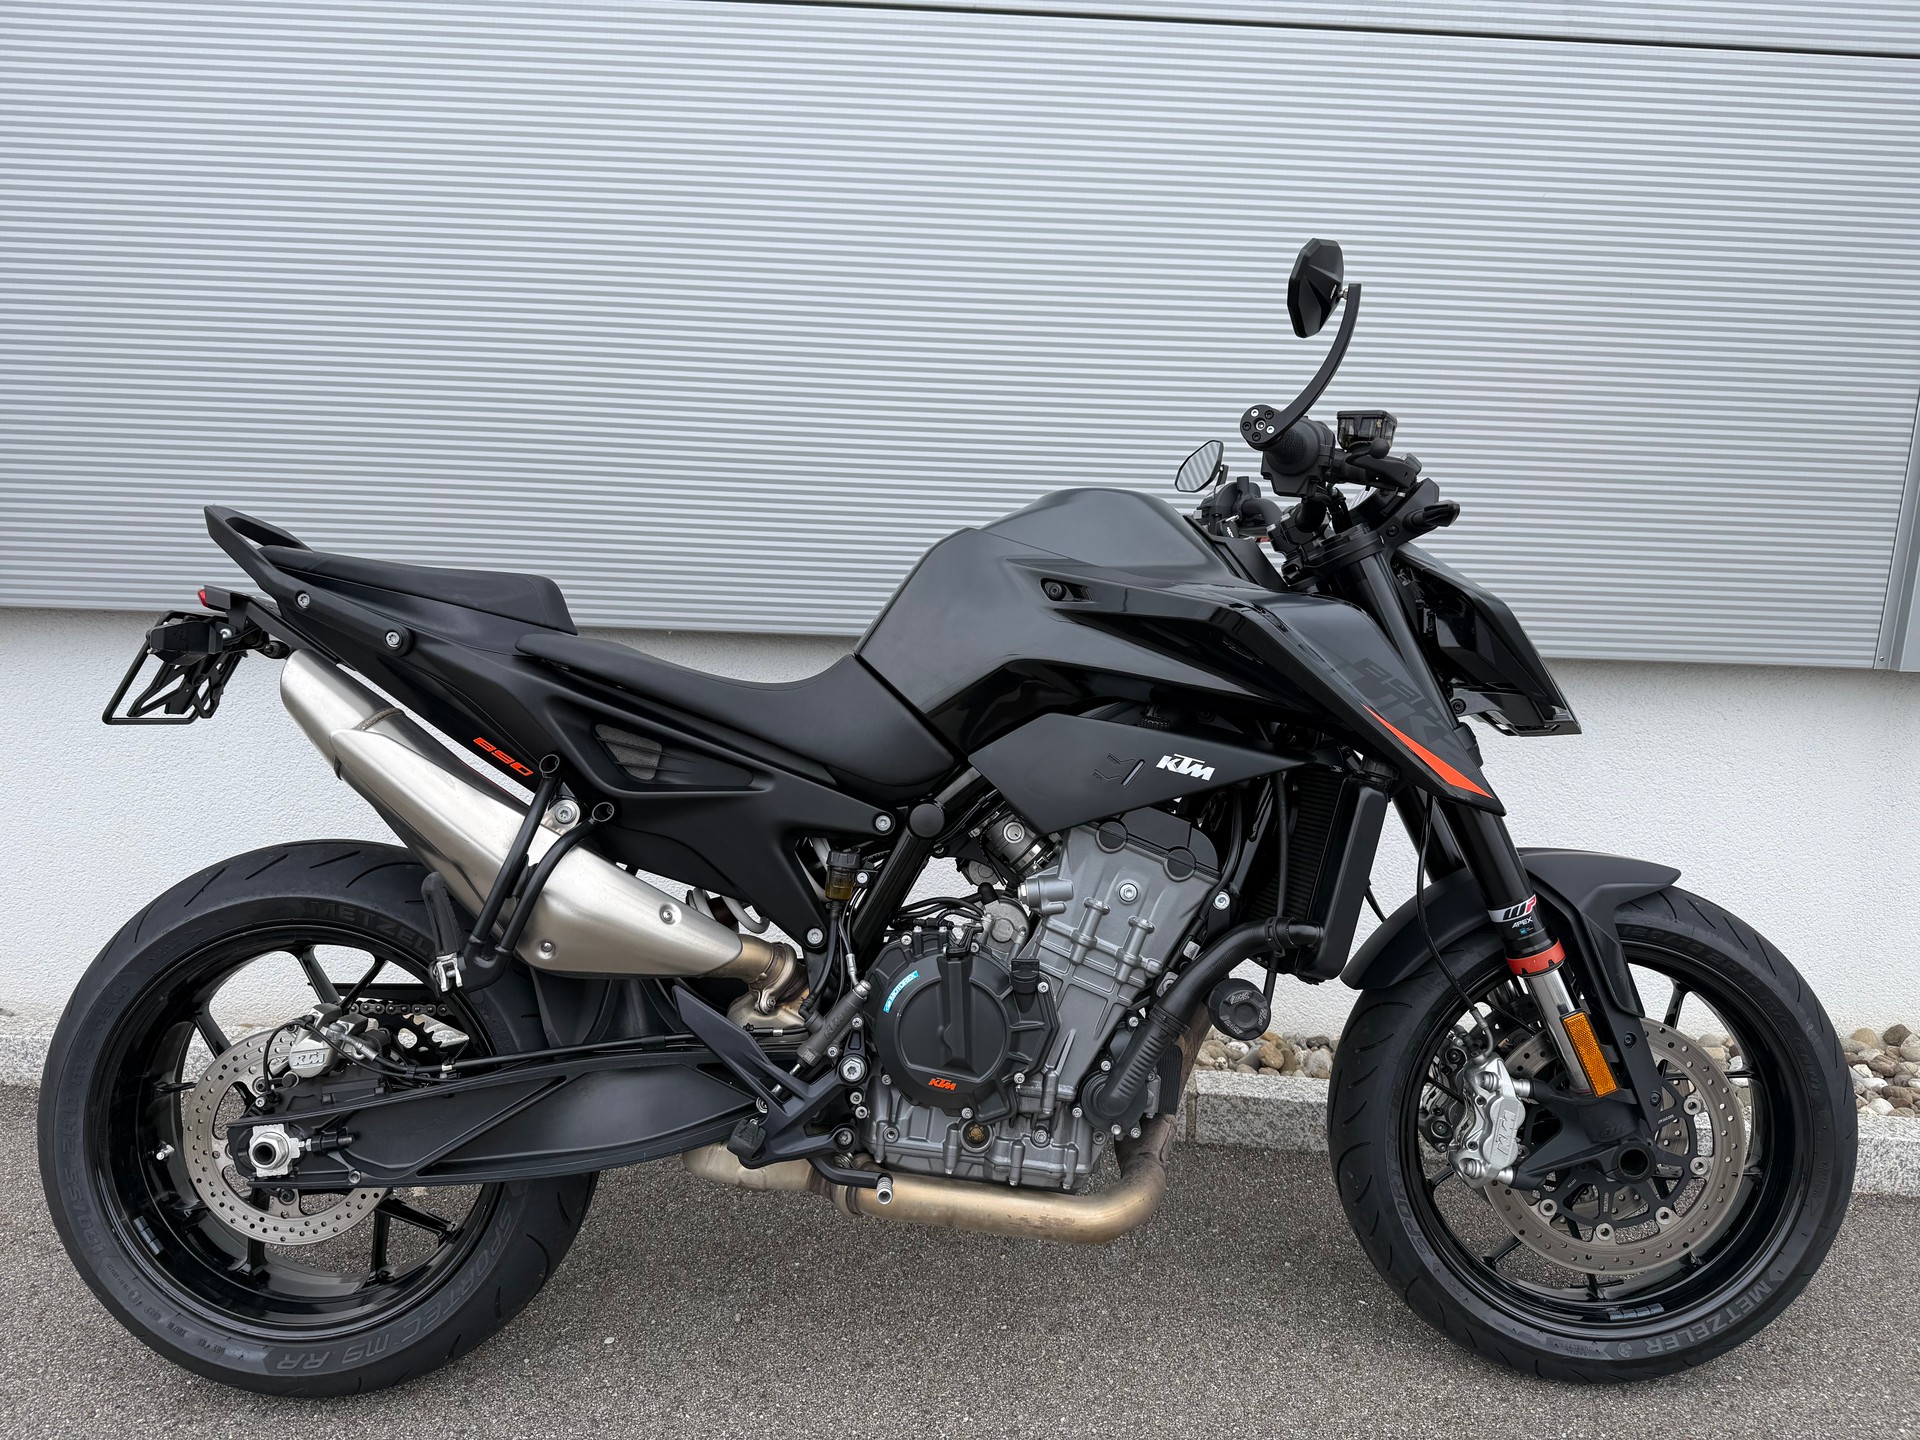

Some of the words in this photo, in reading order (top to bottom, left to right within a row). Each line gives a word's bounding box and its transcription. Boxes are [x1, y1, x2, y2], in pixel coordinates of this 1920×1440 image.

[473, 737, 534, 777] 890
[1156, 753, 1216, 781] KTM
[1503, 896, 1536, 920] WP
[1511, 916, 1533, 929] APEX
[309, 900, 436, 957] METZEL
[928, 1077, 957, 1091] KTM
[1496, 1109, 1517, 1156] KTM
[1385, 1119, 1434, 1260] SPORTEC
[401, 1206, 512, 1342] SPORTEC
[1643, 1277, 1772, 1354] METZELER
[275, 1350, 330, 1369] RR
[341, 1333, 389, 1363] M9
